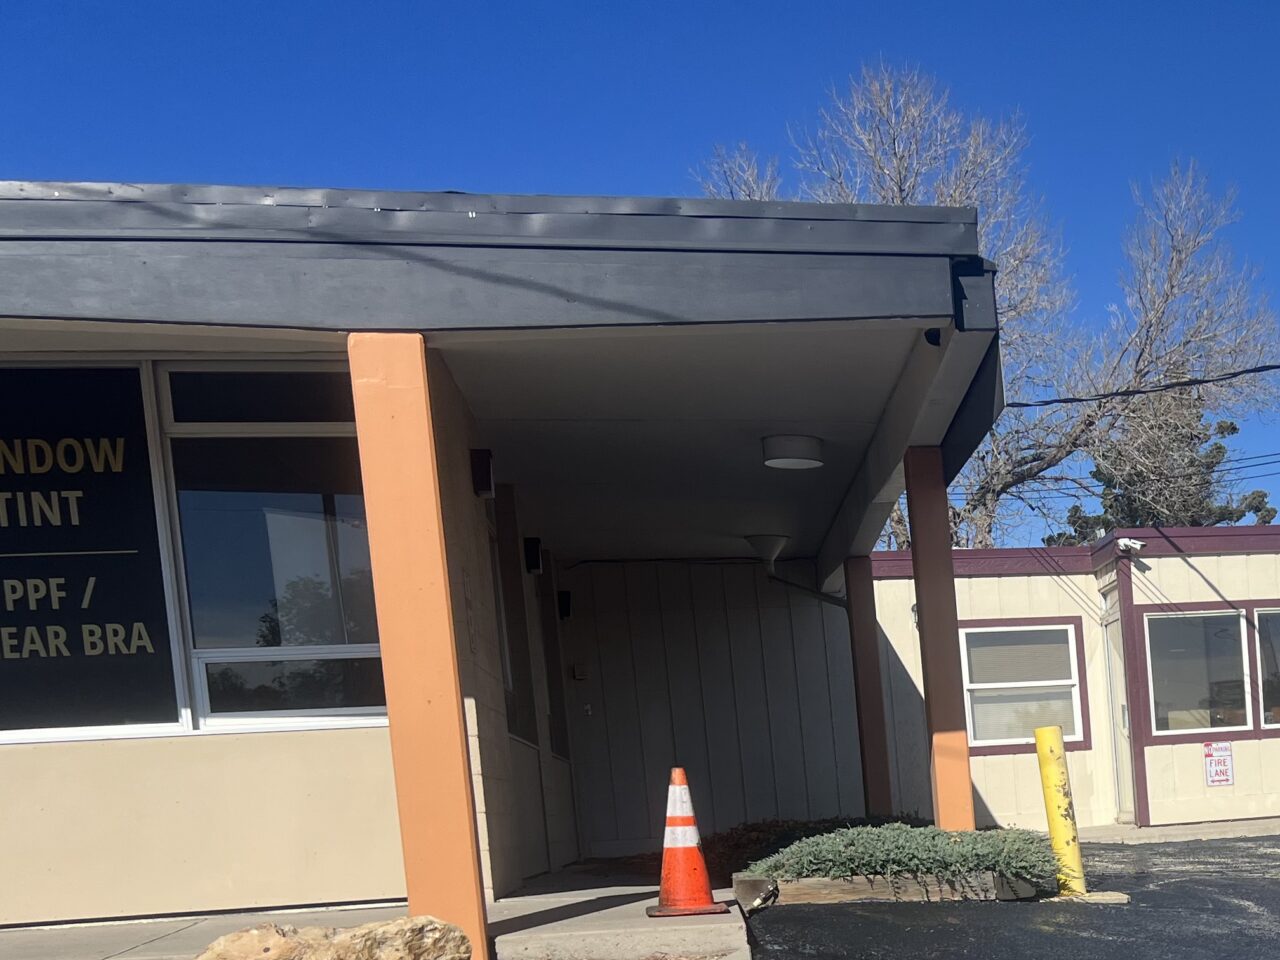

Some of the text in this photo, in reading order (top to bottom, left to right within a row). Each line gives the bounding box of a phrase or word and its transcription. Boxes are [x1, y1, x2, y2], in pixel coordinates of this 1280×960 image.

[0, 437, 125, 474] NDOW
[0, 490, 84, 527] TINT
[3, 576, 96, 611] PPF /
[0, 622, 155, 659] EAR BRA
[1210, 758, 1228, 767] FIRE
[1210, 768, 1230, 778] LANE
